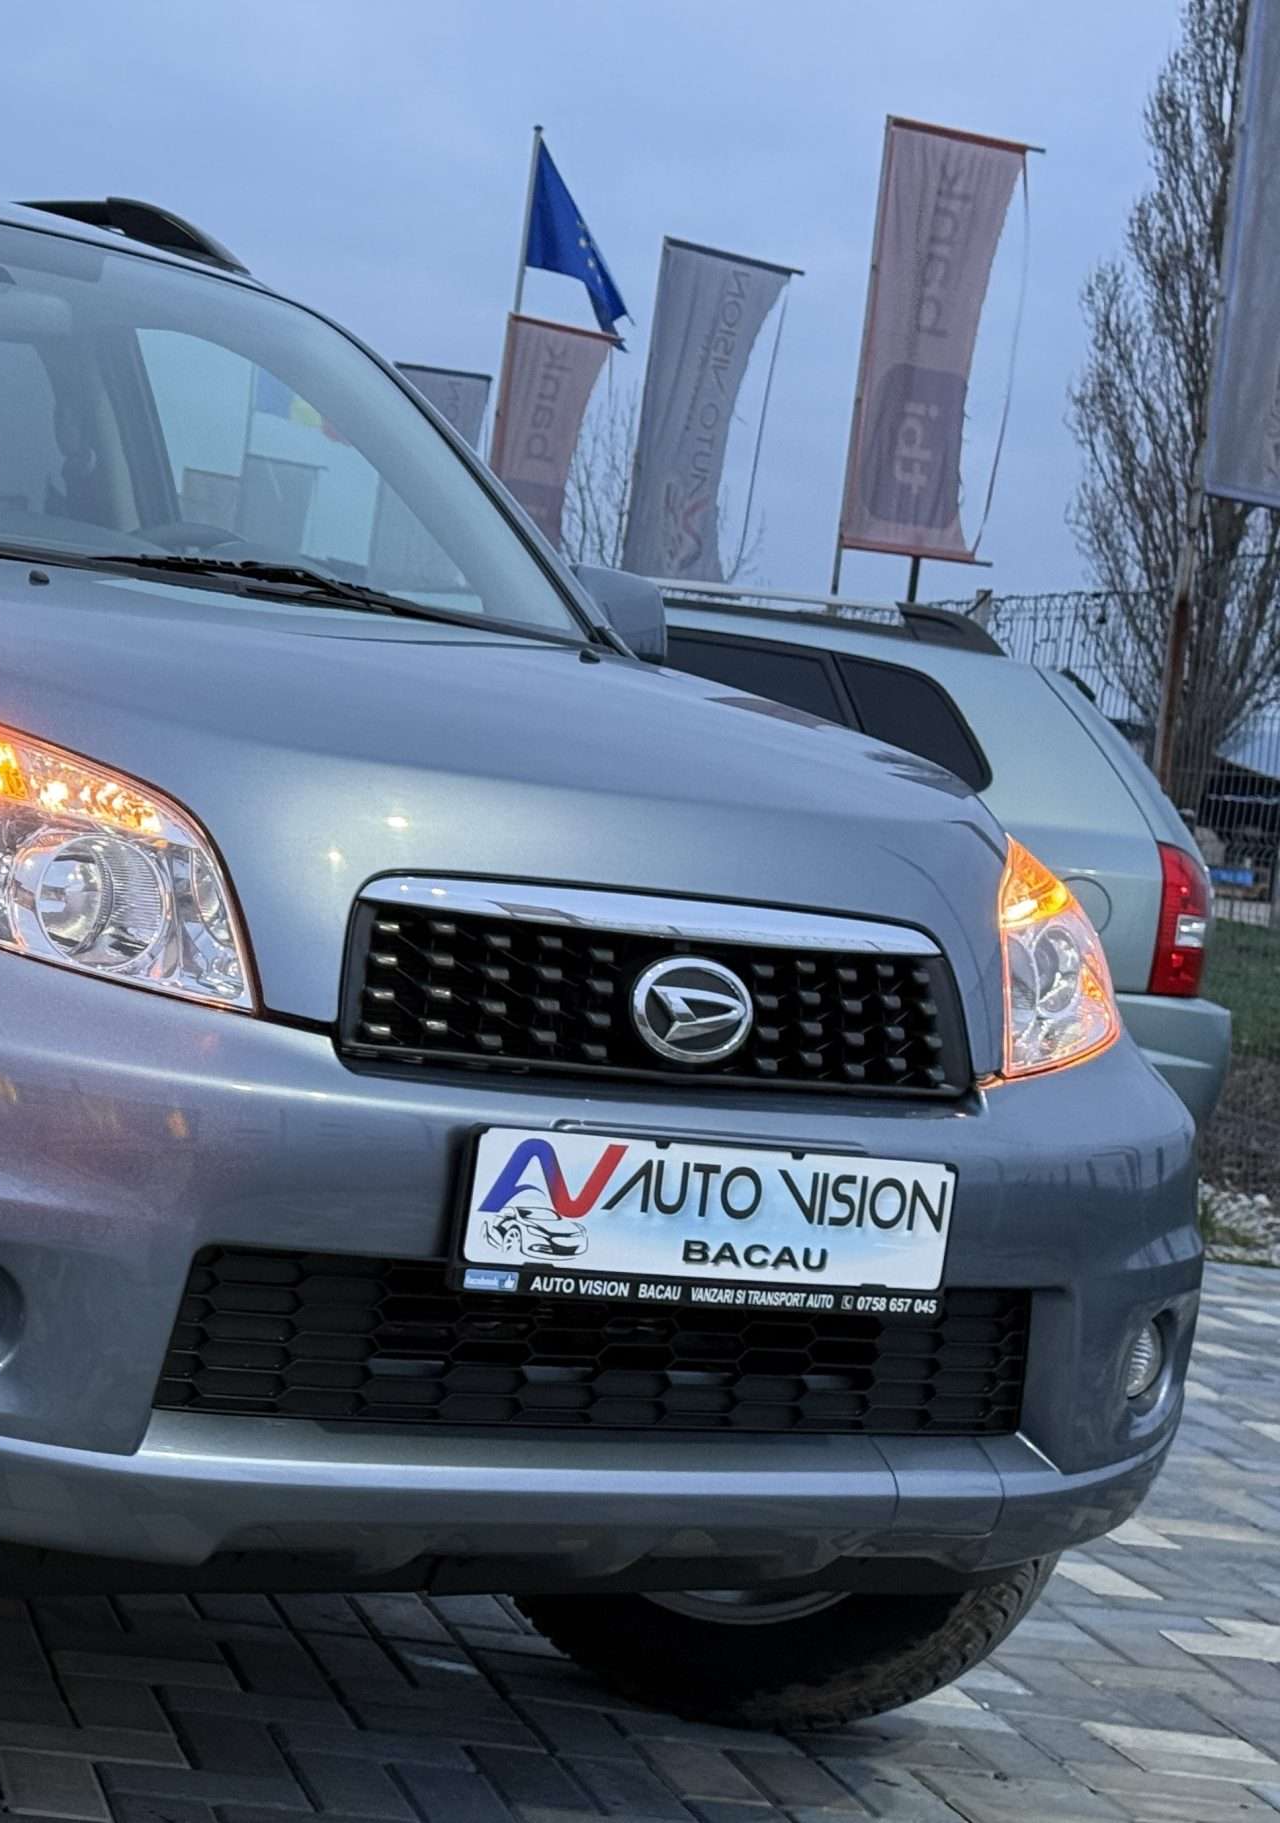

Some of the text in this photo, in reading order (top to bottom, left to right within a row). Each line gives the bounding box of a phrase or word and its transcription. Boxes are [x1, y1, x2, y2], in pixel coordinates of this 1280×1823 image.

[600, 1159, 949, 1234] AUTO VISION
[681, 1239, 829, 1272] BACAU
[530, 1276, 938, 1315] AUTO VISION BACAU VANZARI SI TRANSPORT AUTO 0758 657 045
